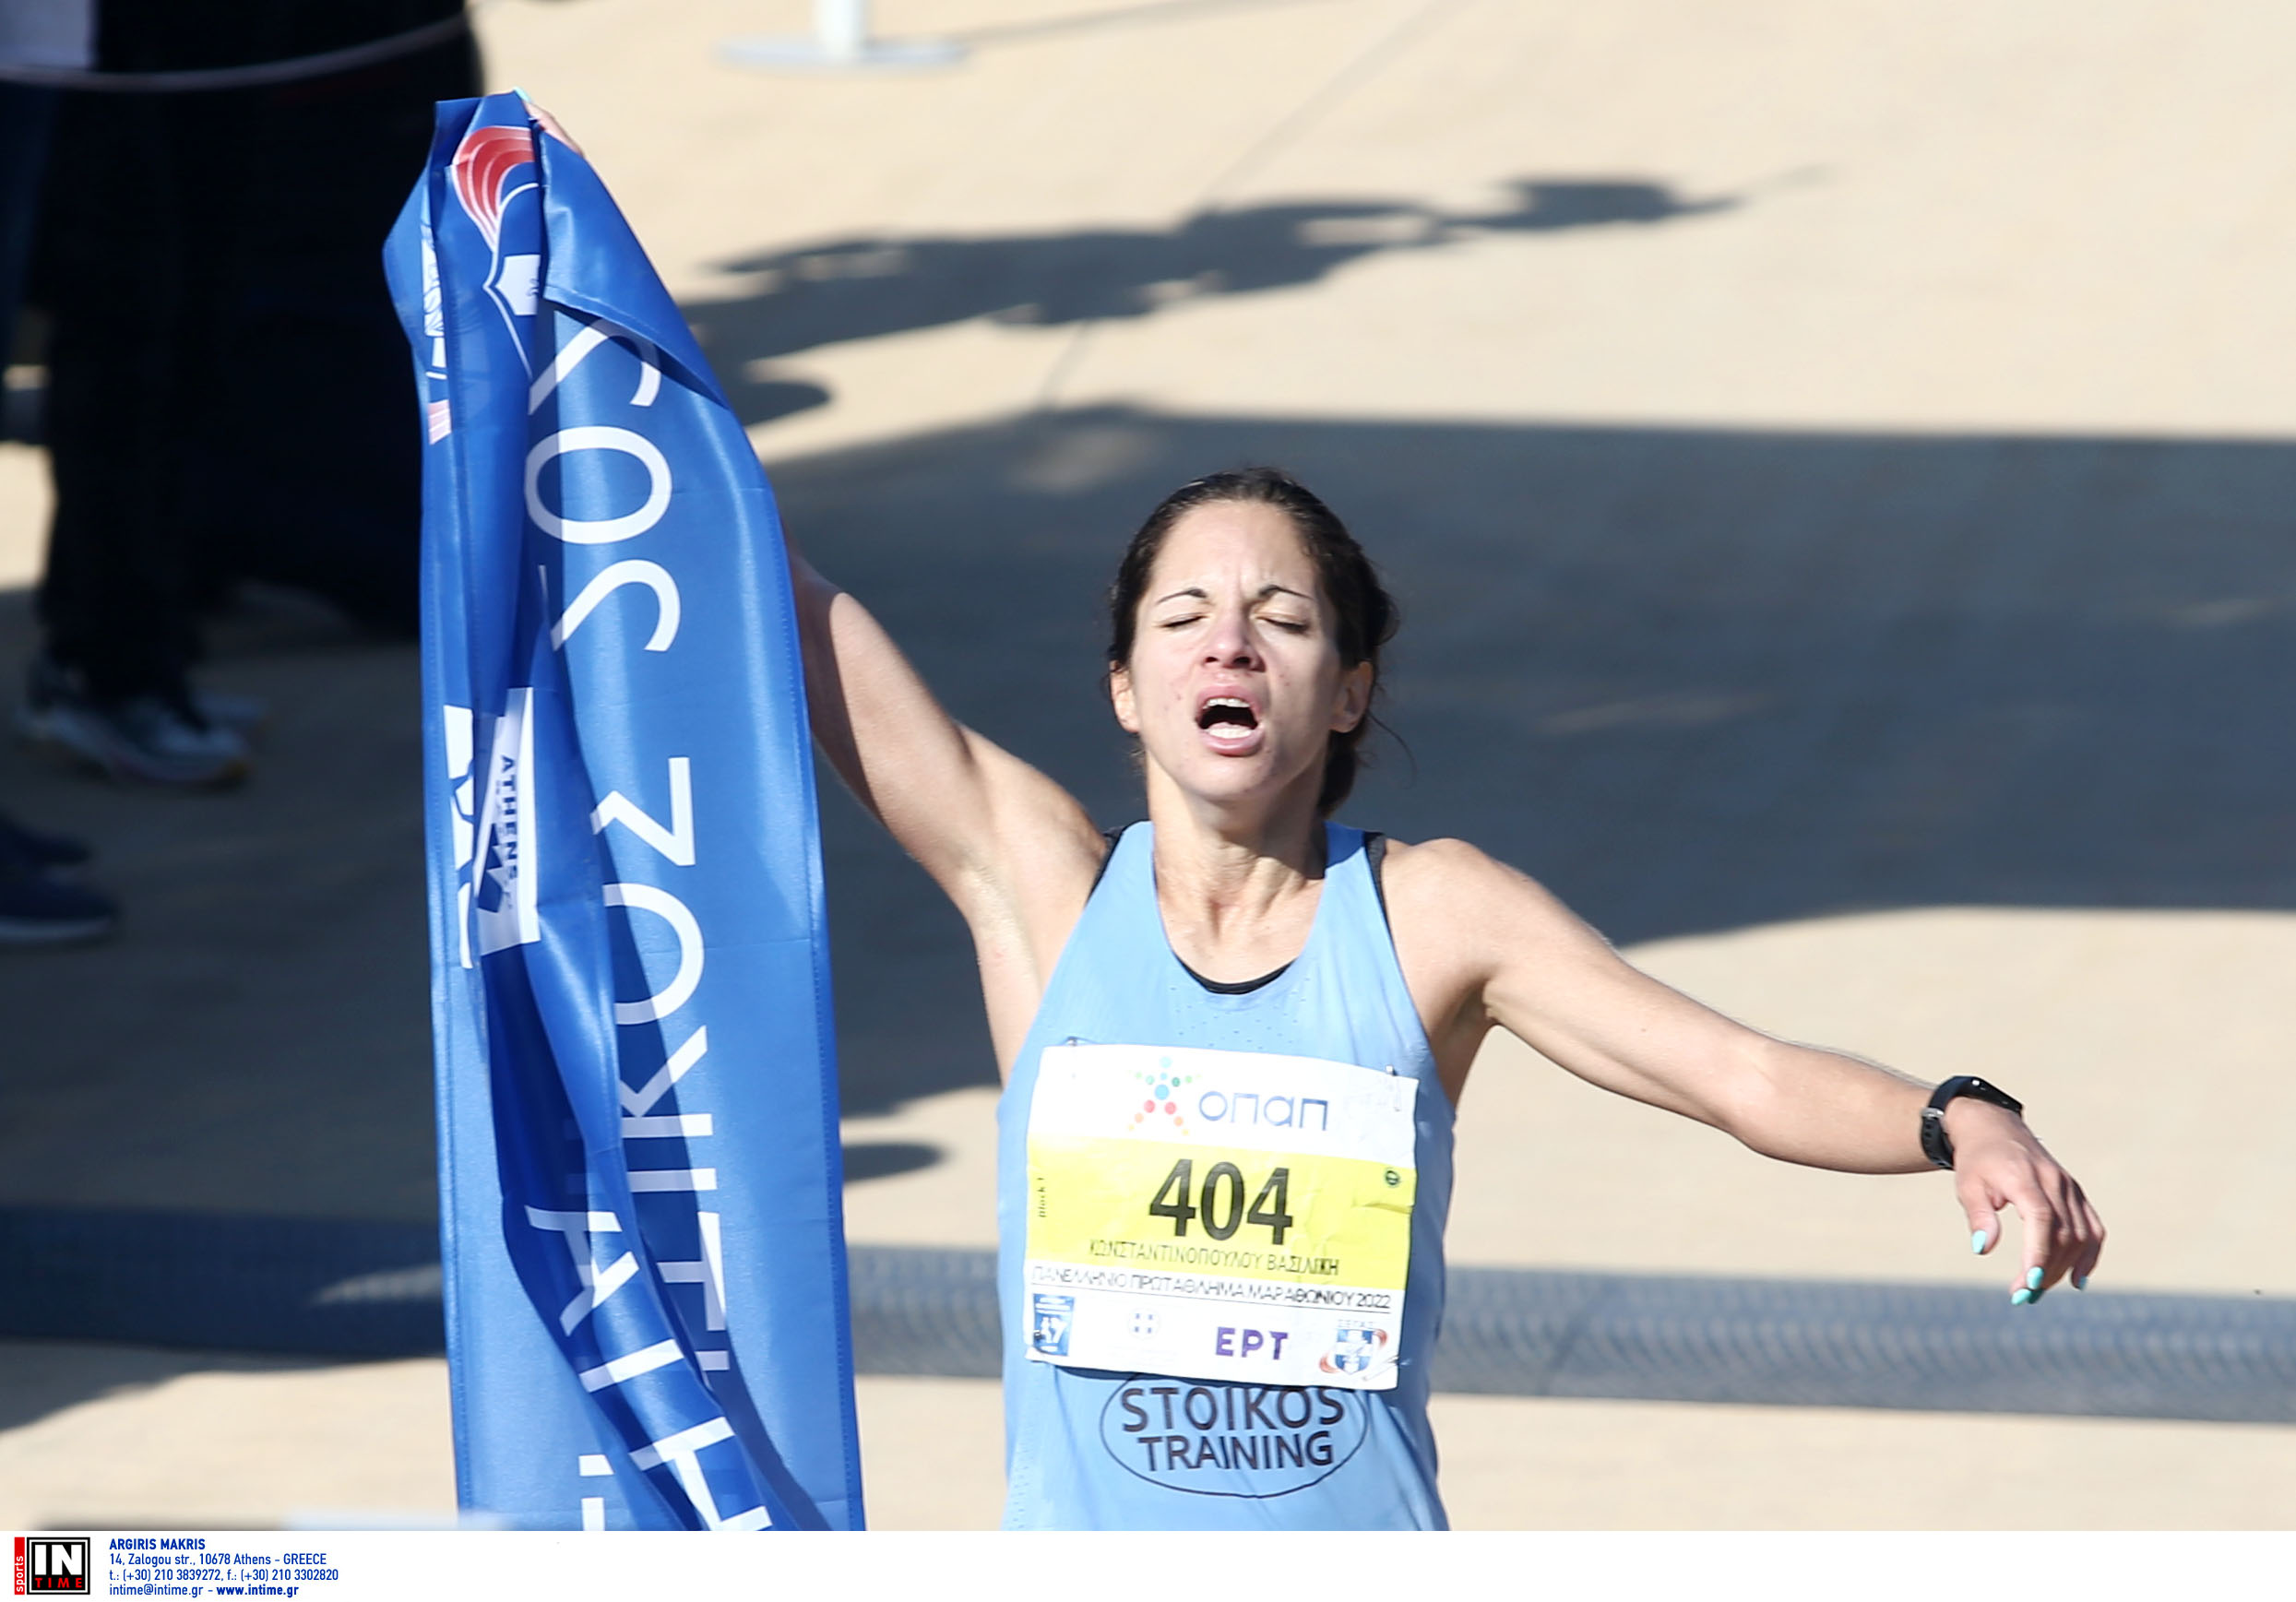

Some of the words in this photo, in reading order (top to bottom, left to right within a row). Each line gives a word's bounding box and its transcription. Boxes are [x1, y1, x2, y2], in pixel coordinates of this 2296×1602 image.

[500, 754, 519, 881] ATHENS
[1148, 1158, 1293, 1245] 404
[1088, 1239, 1263, 1270] ΚΩΝΣΤΑΝΤΙΝΟΠΟΥΛΟΥ
[1267, 1253, 1340, 1276] ΒΑΣΙΛΙΚΗ
[1031, 1265, 1127, 1288] ΠΑΝΕΛΛΗΝΙΟ
[1130, 1274, 1244, 1297] ΠΡΩΤΑΘΛΗΜΑ
[1247, 1284, 1354, 1307] ΜΑΡΑΘΩΝΙΟΥ
[1355, 1292, 1391, 1310] 2022
[1215, 1325, 1289, 1360] ΕΡΤ
[1121, 1386, 1344, 1432] STOIKOS
[1137, 1430, 1334, 1472] TRAINING
